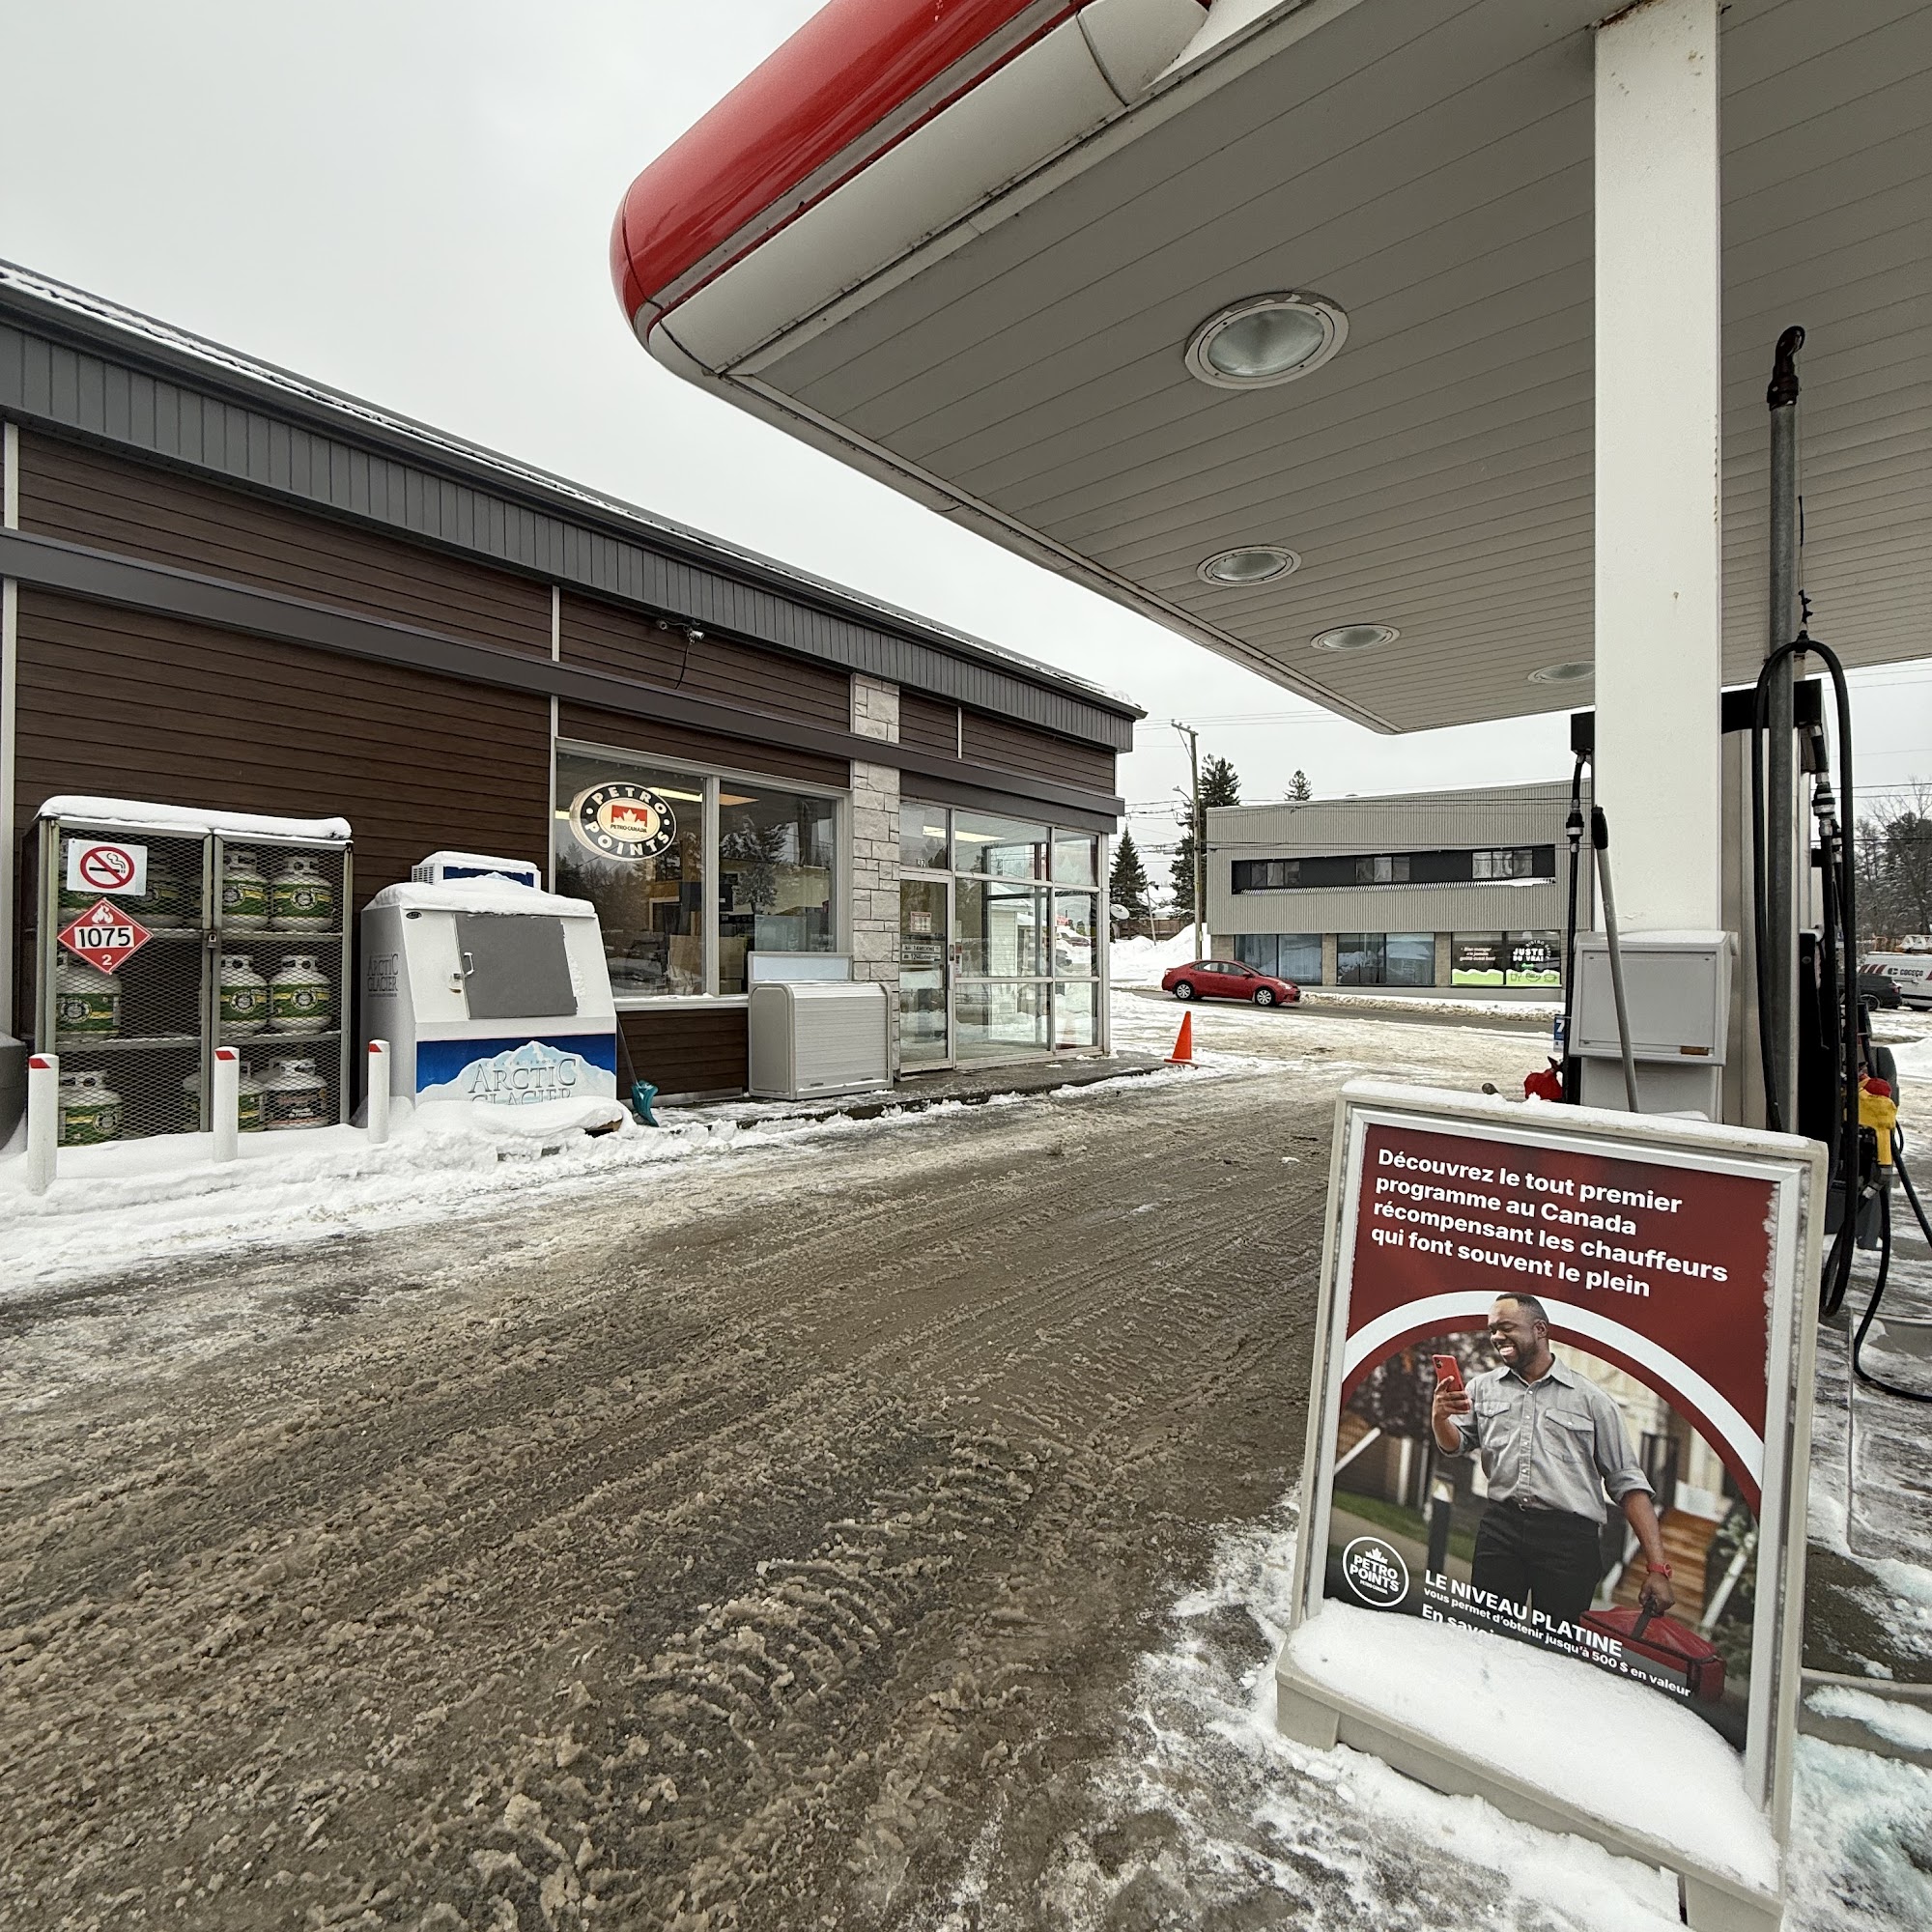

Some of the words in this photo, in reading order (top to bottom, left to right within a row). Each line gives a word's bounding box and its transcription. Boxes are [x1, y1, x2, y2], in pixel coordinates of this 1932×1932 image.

[591, 786, 667, 814] PETRO
[584, 821, 669, 855] POINTS
[79, 927, 130, 947] 1075
[101, 954, 112, 965] 2
[367, 953, 398, 976] ARCTIC
[1513, 948, 1544, 956] JUSTE
[368, 977, 398, 991] GLACIER
[468, 1059, 577, 1094] ARCTIC
[1378, 1149, 1494, 1183] Découvrez
[1499, 1167, 1520, 1186] le
[1524, 1173, 1575, 1196] tout
[1579, 1183, 1683, 1213] premier
[1376, 1177, 1501, 1210] programme
[1505, 1200, 1535, 1217] au
[1541, 1203, 1636, 1236] Canada
[1374, 1201, 1534, 1245] récompensant
[1539, 1230, 1575, 1253] les
[1580, 1239, 1728, 1282] chauffeurs
[1371, 1228, 1404, 1246] qui
[1408, 1232, 1453, 1256] font
[1458, 1244, 1553, 1277] souvent
[1558, 1262, 1580, 1282] le
[1585, 1270, 1650, 1297] plein
[1350, 1564, 1400, 1592] POINTS
[1353, 1554, 1398, 1579] PETRO
[1422, 1603, 1444, 1623] En
[1425, 1569, 1448, 1591] LE
[1451, 1578, 1527, 1620] NIVEAU
[1531, 1608, 1623, 1659] PLATINE
[1424, 1587, 1449, 1604] vous
[1451, 1598, 1491, 1620] permet
[1492, 1613, 1544, 1639] d'obtenir
[1545, 1632, 1590, 1658] jusqu'à
[1592, 1651, 1617, 1669] 500
[1619, 1661, 1629, 1674] $
[1631, 1667, 1647, 1681] en
[1649, 1673, 1691, 1697] valeur
